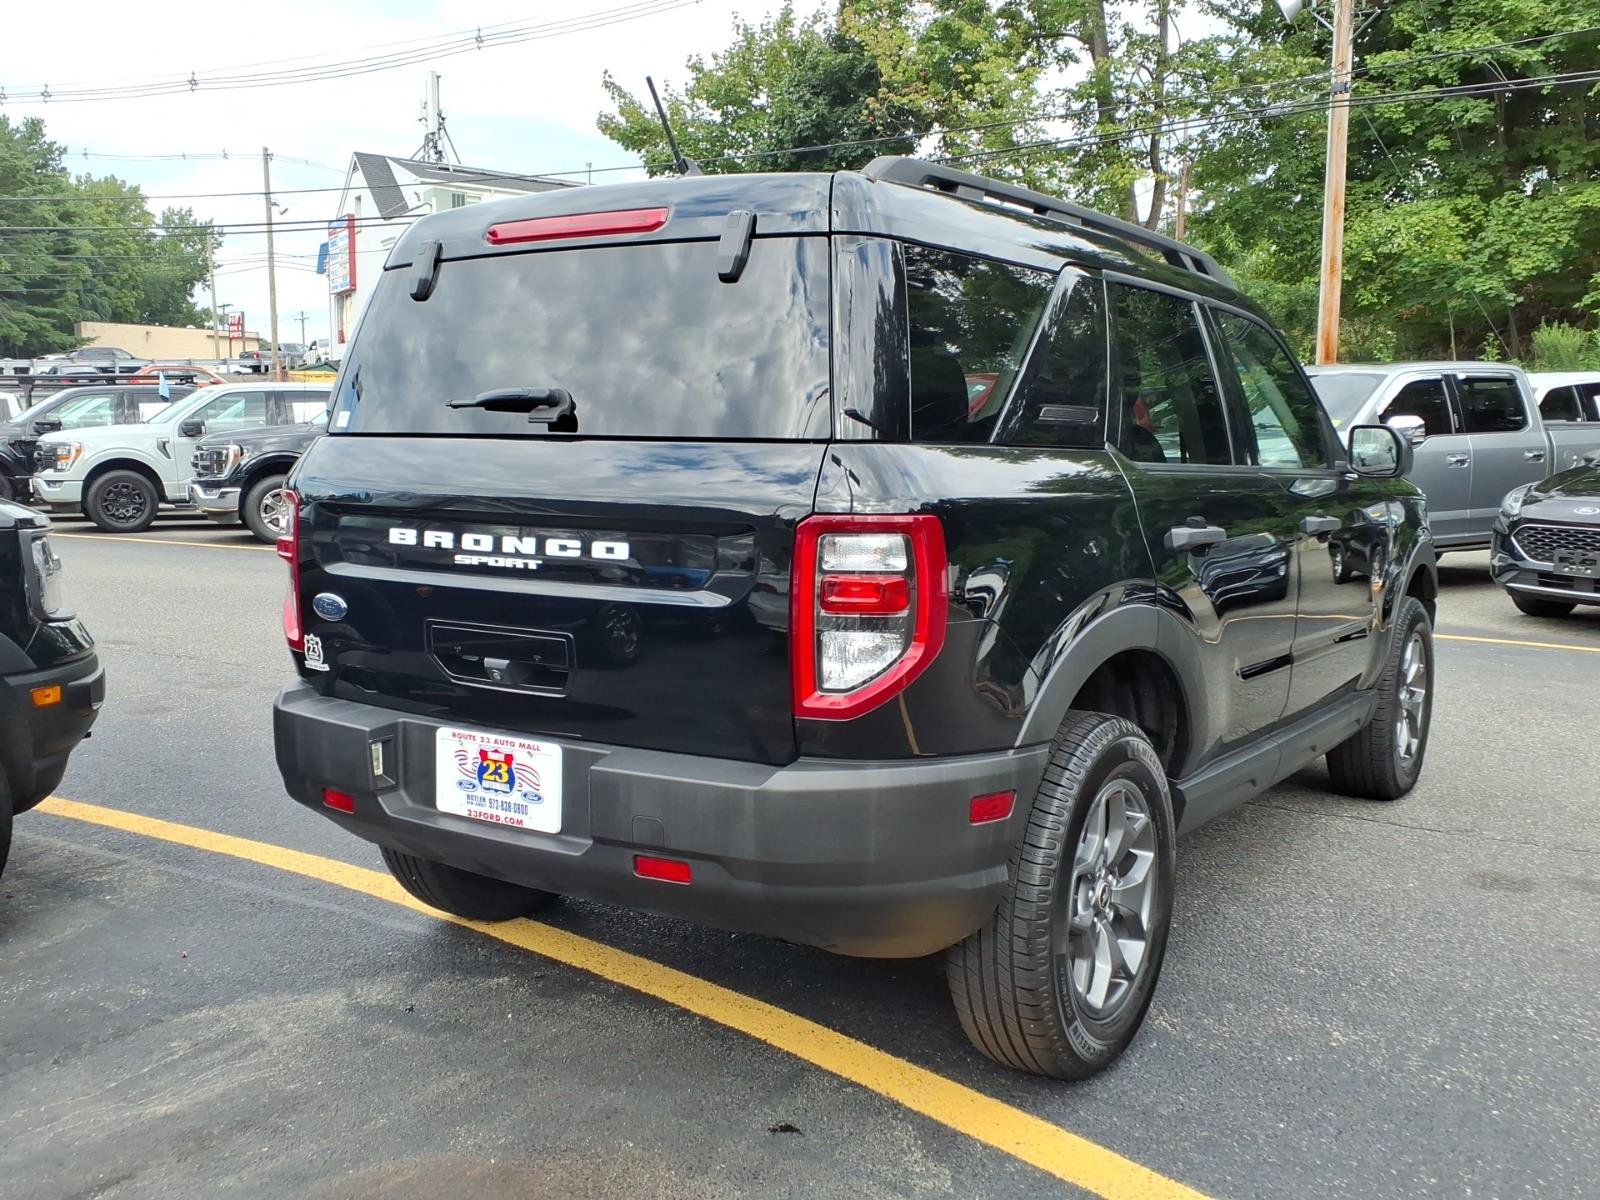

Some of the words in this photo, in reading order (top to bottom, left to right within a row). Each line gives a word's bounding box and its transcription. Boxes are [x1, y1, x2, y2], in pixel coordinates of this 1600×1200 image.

[389, 527, 630, 560] BRONCO
[454, 554, 543, 570] SPORT
[307, 643, 319, 657] 23
[452, 731, 476, 741] ROUTE
[480, 736, 491, 744] 23
[493, 738, 516, 748] AUTO
[518, 743, 541, 752] MALL
[482, 759, 509, 783] 23
[467, 809, 524, 826] 23FORD.COM
